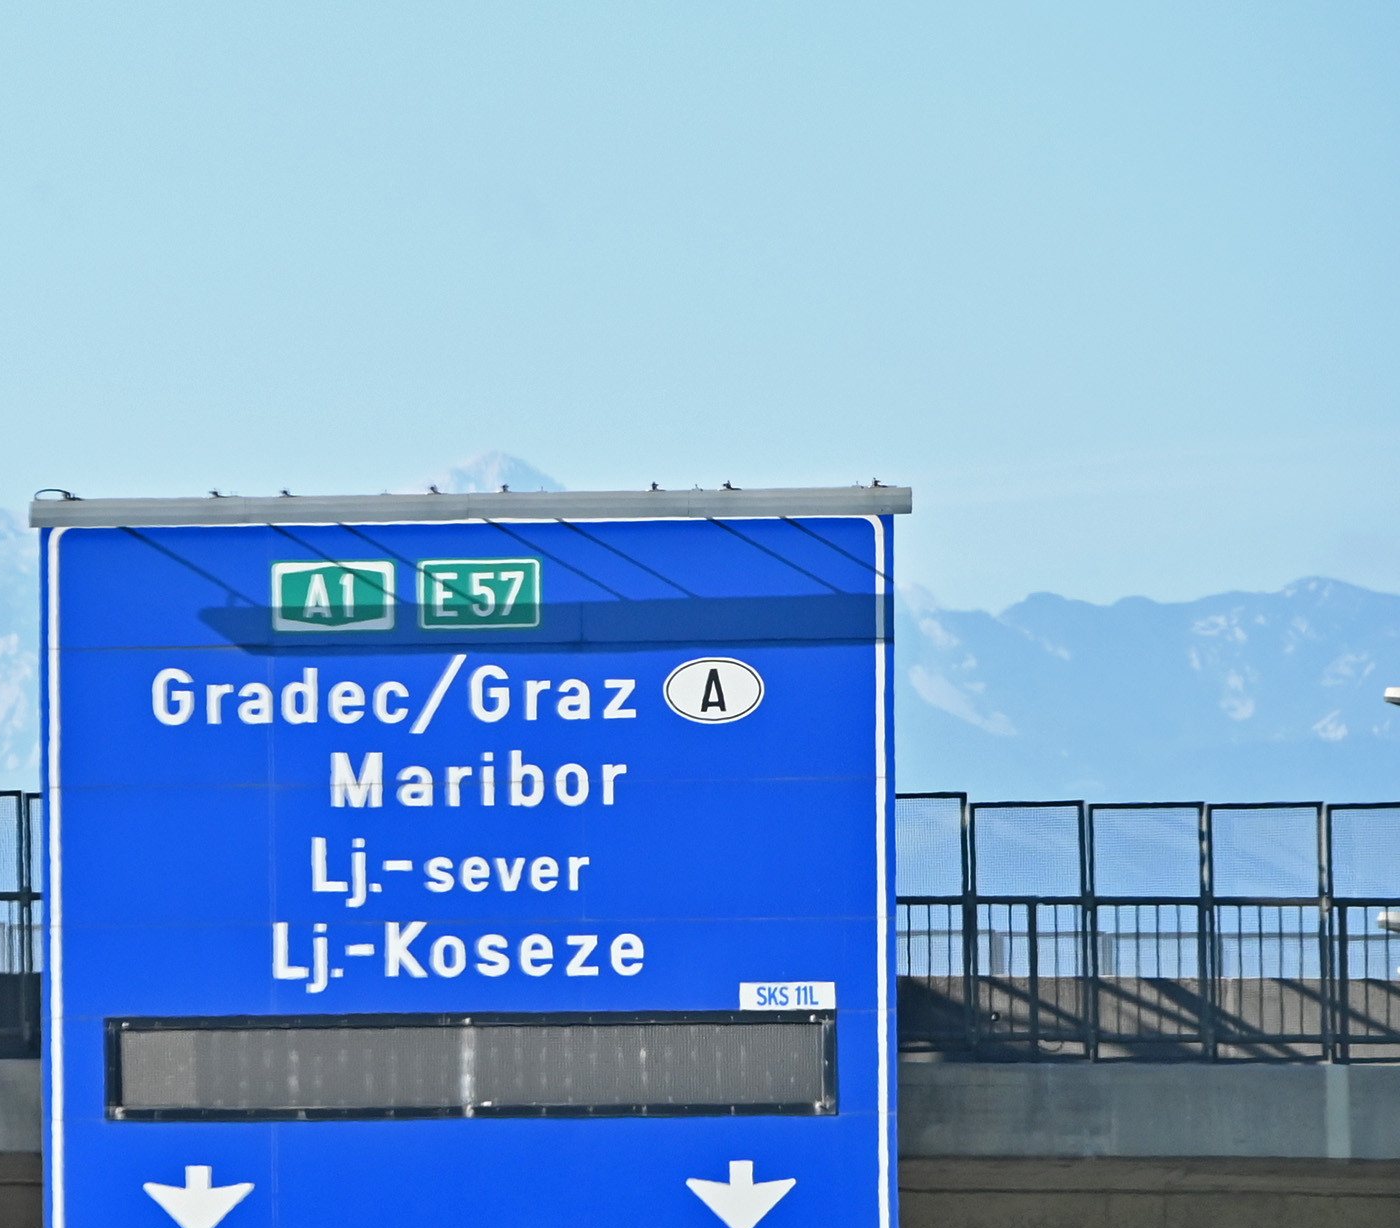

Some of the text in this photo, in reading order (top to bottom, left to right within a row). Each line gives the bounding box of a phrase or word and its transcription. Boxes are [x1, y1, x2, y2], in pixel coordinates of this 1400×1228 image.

[303, 573, 356, 618] A1
[431, 571, 525, 617] E 57
[151, 654, 637, 734] Gradec/Graz
[699, 668, 727, 713] A
[330, 750, 628, 808] Maribor
[310, 836, 591, 907] Lj.-sever
[271, 921, 646, 994] Lj.-Koseze
[756, 985, 820, 1006] SKS 11L
